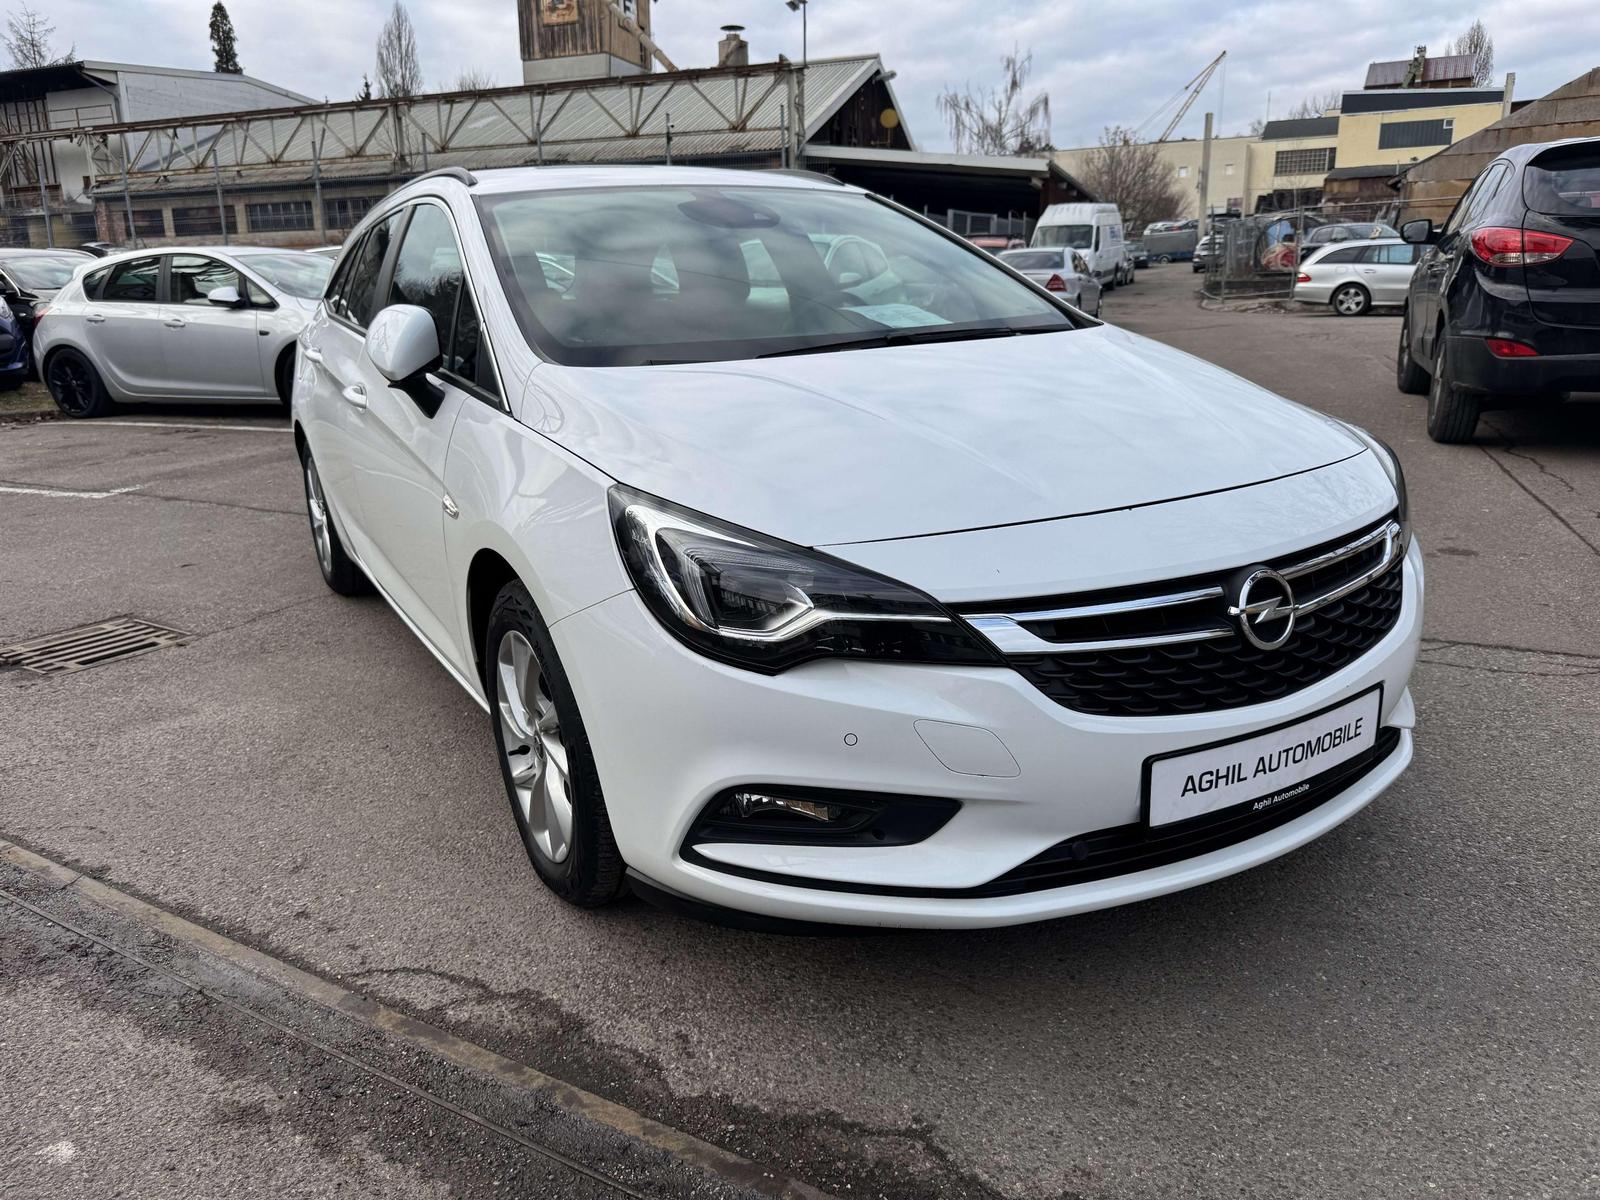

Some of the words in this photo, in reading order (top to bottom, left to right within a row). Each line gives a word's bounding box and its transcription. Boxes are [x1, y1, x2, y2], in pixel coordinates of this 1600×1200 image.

[1181, 763, 1248, 797] AGHIL
[1253, 717, 1364, 779] AUTOMOBILE
[1252, 797, 1272, 811] Aghil
[1273, 784, 1310, 804] Automobile
